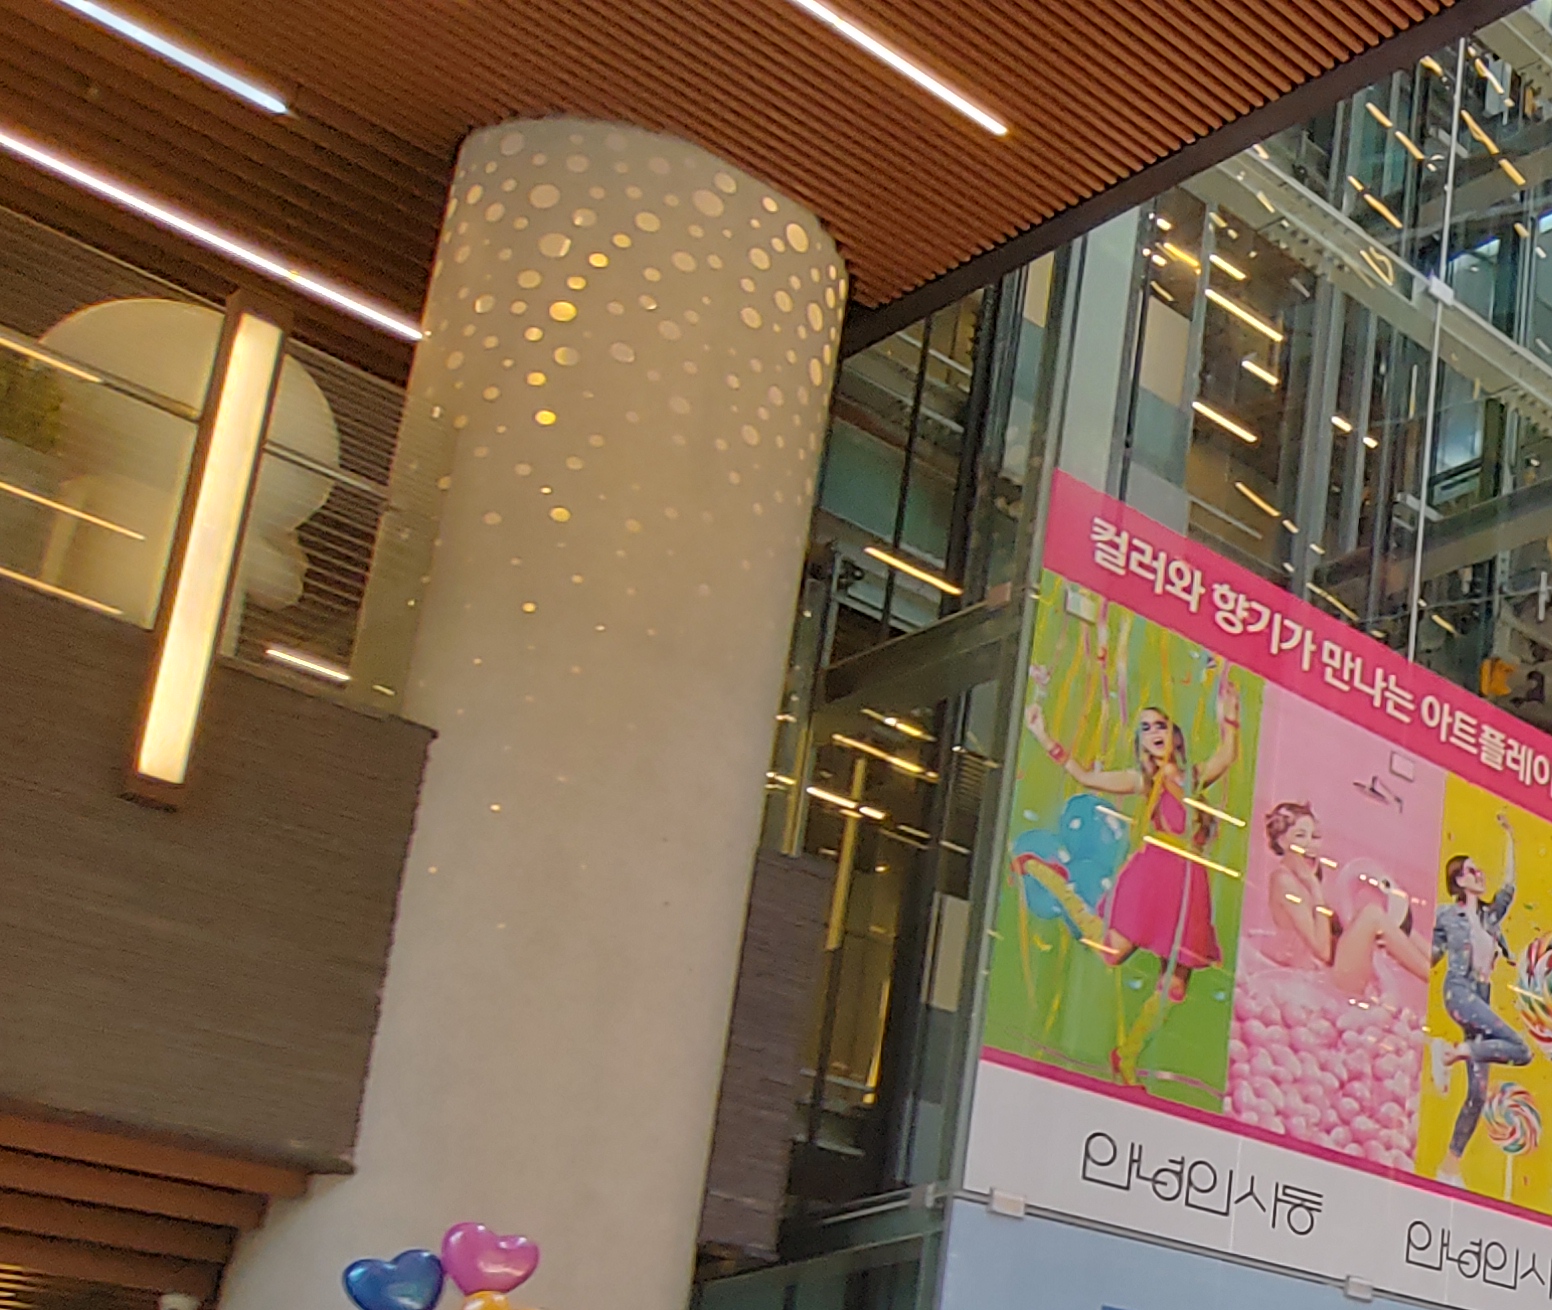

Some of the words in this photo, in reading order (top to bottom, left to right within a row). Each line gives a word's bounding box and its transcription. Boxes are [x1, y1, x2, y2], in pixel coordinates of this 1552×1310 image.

[1091, 516, 1205, 613] 컬러와
[1213, 583, 1316, 671] 향기가
[1322, 640, 1416, 723] 만나는
[1080, 1130, 1324, 1239] 안녕인사동
